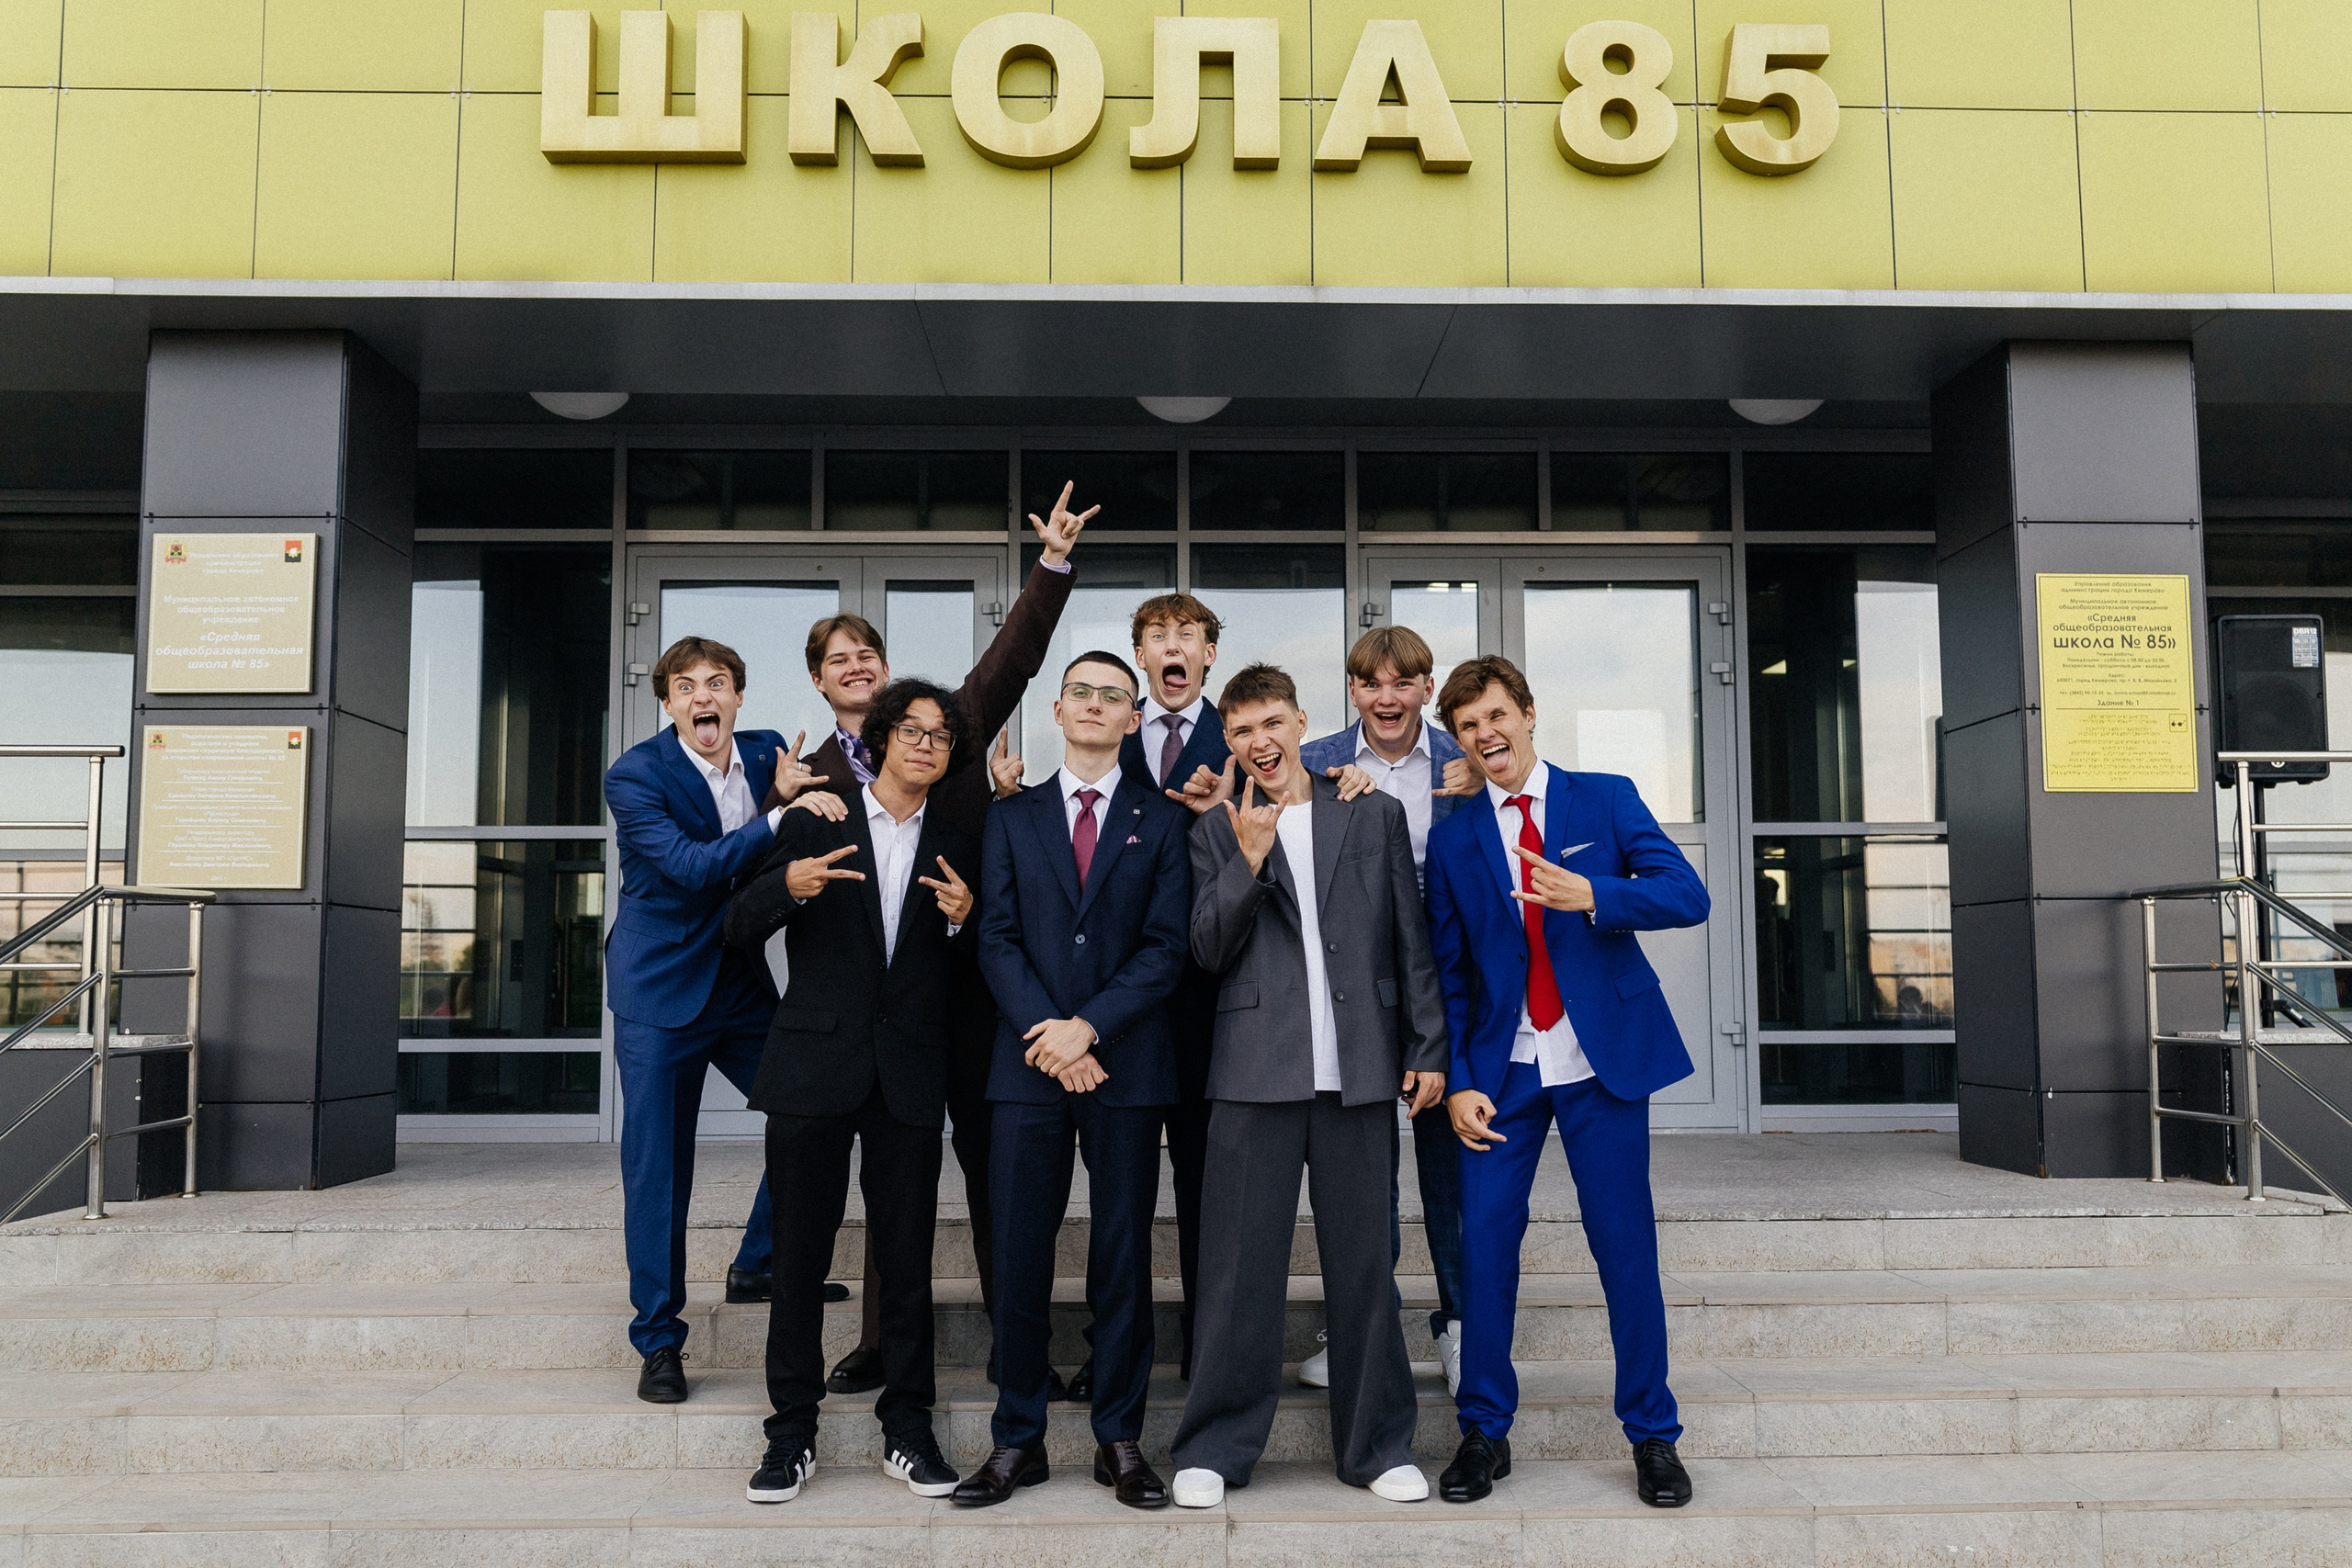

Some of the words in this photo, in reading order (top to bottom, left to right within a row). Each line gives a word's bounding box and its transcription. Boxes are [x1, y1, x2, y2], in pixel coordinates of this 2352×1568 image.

[540, 8, 1472, 173] ШКОЛА
[1553, 19, 1839, 176] 85
[164, 595, 241, 604] Муниципальное
[176, 605, 286, 614] общеобразовательное
[202, 616, 259, 625] учреждение
[2087, 613, 2136, 623] «Средняя
[2052, 623, 2172, 633] общеобразовательная
[199, 631, 261, 643] «Средняя
[2053, 637, 2114, 649] школа
[2120, 634, 2141, 649] №
[2146, 634, 2177, 649] 85»
[155, 645, 304, 657] общеобразовательная
[187, 660, 228, 669] школа
[231, 659, 246, 669] №
[249, 659, 270, 669] 85»
